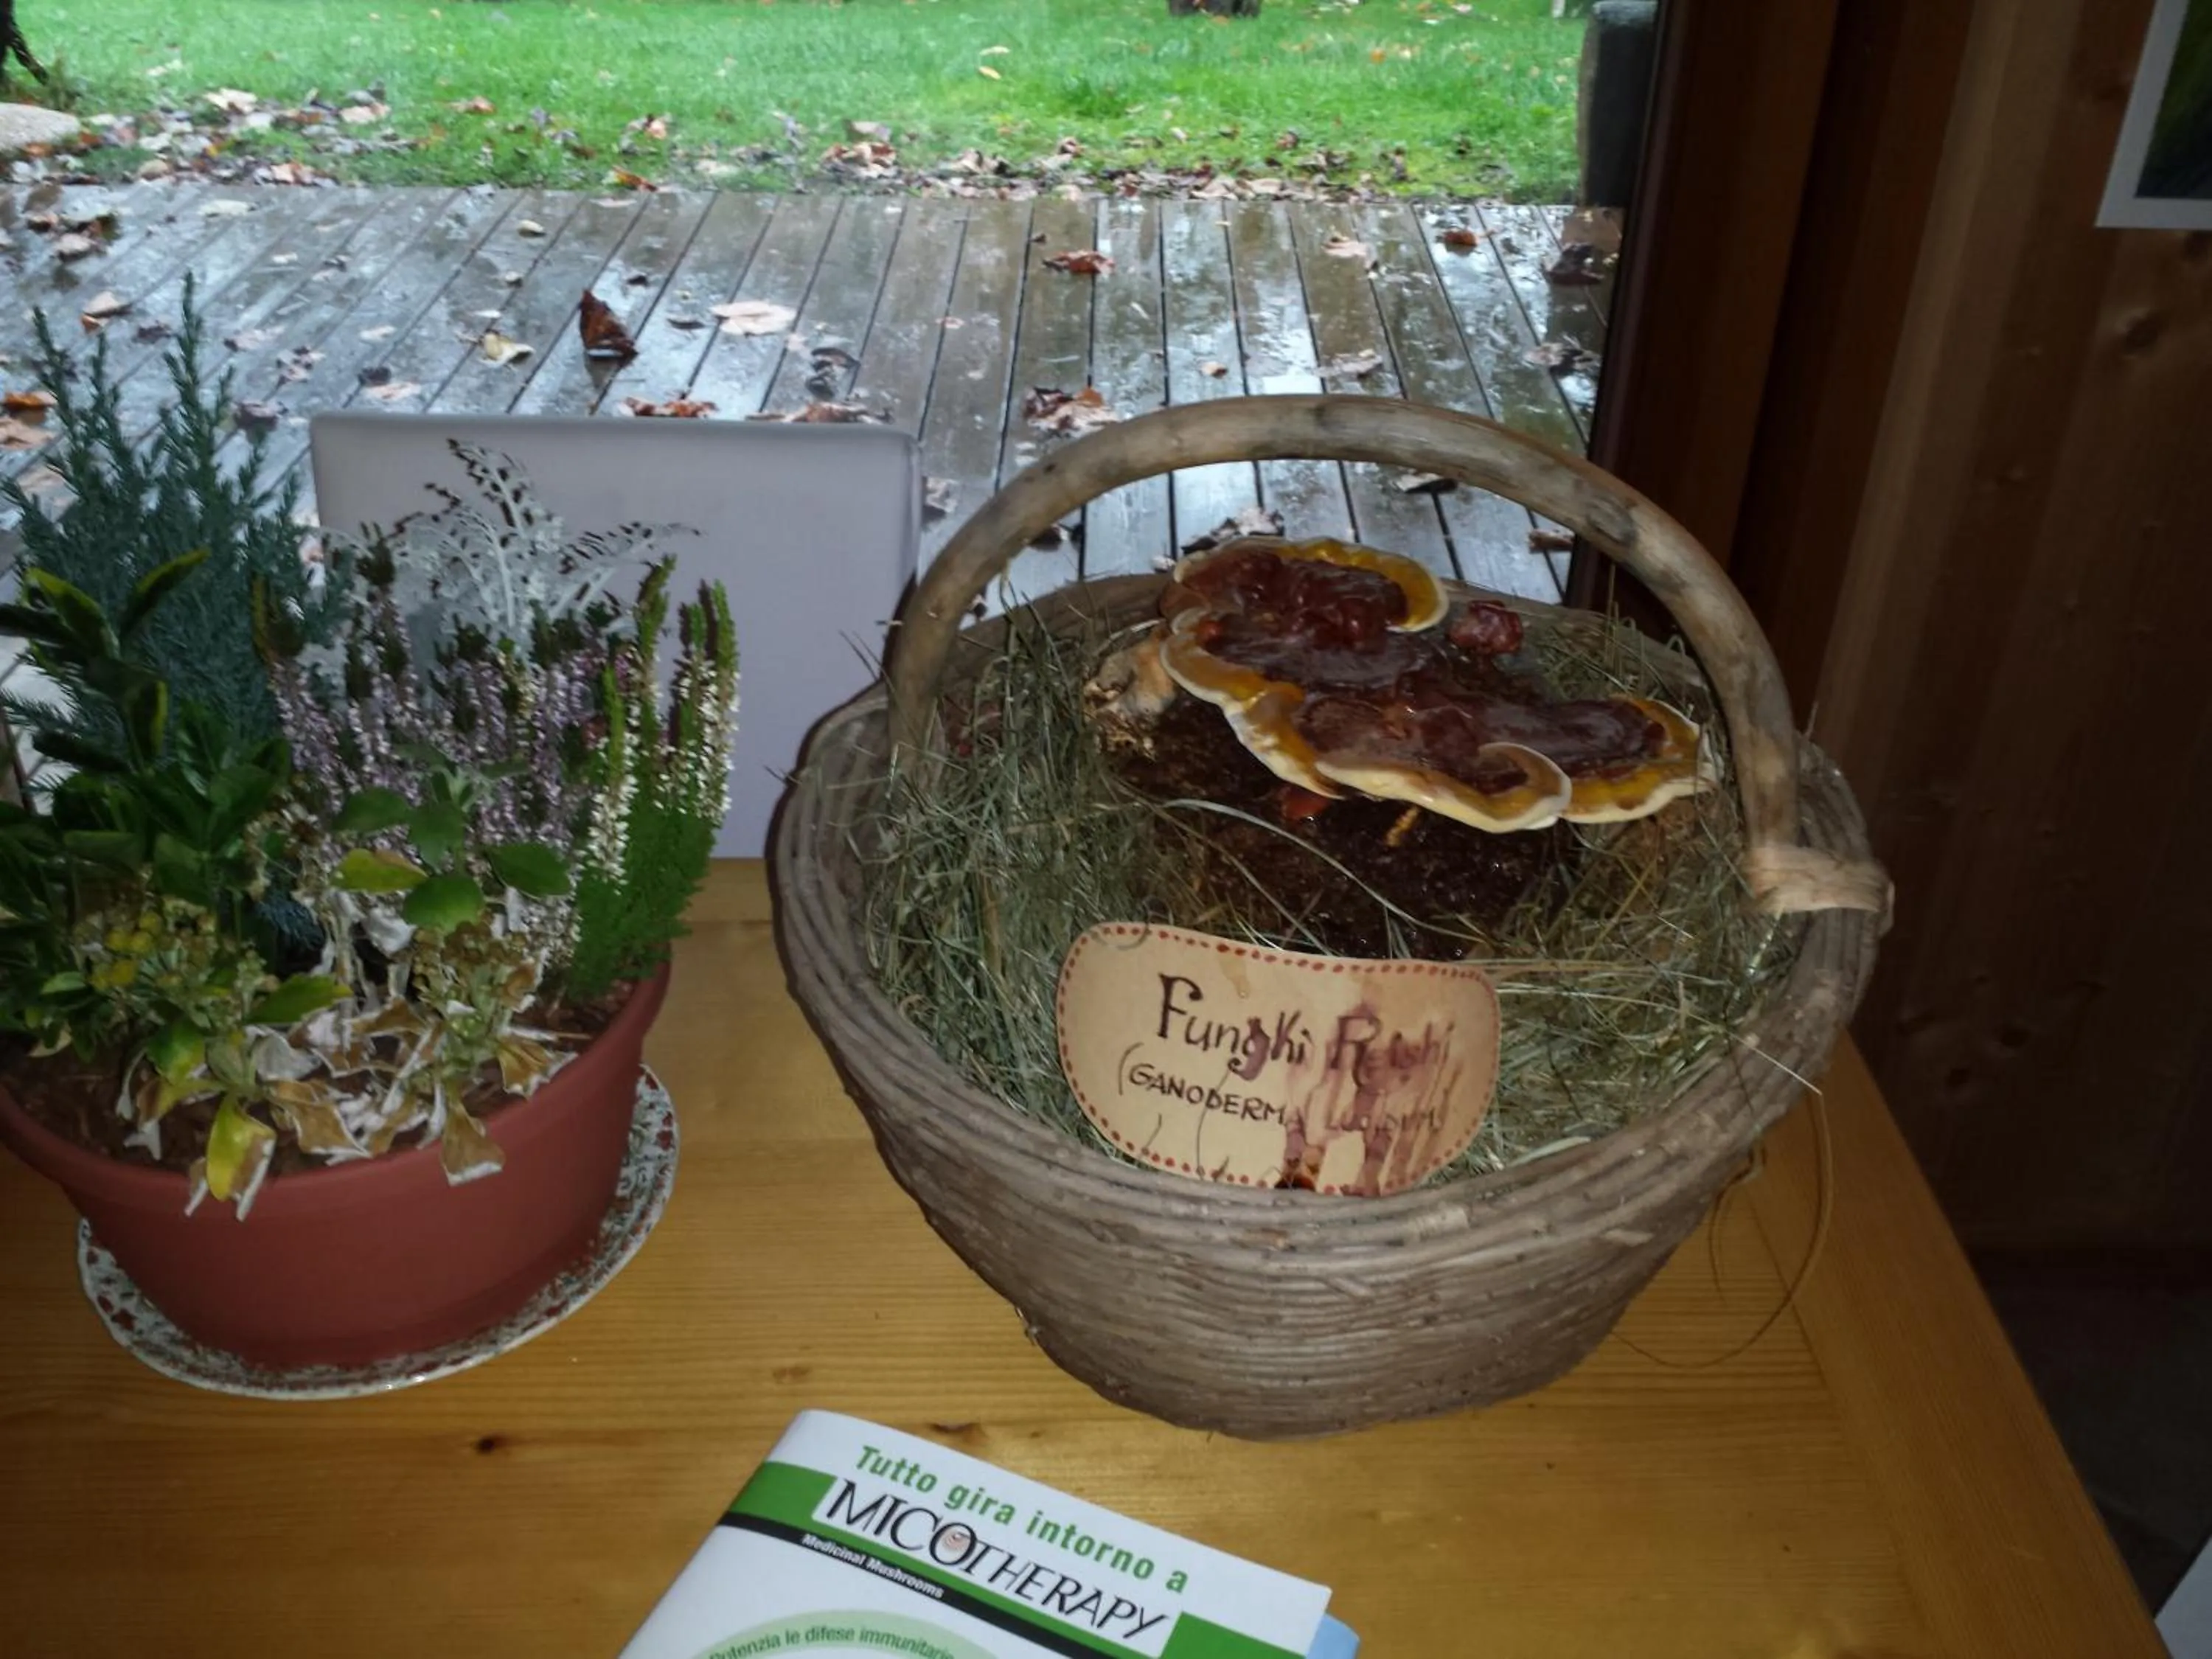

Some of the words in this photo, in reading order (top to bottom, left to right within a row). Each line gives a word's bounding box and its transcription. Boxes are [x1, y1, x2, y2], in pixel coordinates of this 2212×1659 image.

[801, 1532, 865, 1568] Medicinal
[866, 1554, 945, 1600] Mushrooms
[826, 1477, 1169, 1641] MICOTHERAPY
[855, 1445, 939, 1493] Tutto
[943, 1484, 1016, 1526] gira
[1026, 1509, 1155, 1580] intorno
[1165, 1569, 1189, 1593] a
[785, 1628, 801, 1646] le
[804, 1625, 855, 1643] difese
